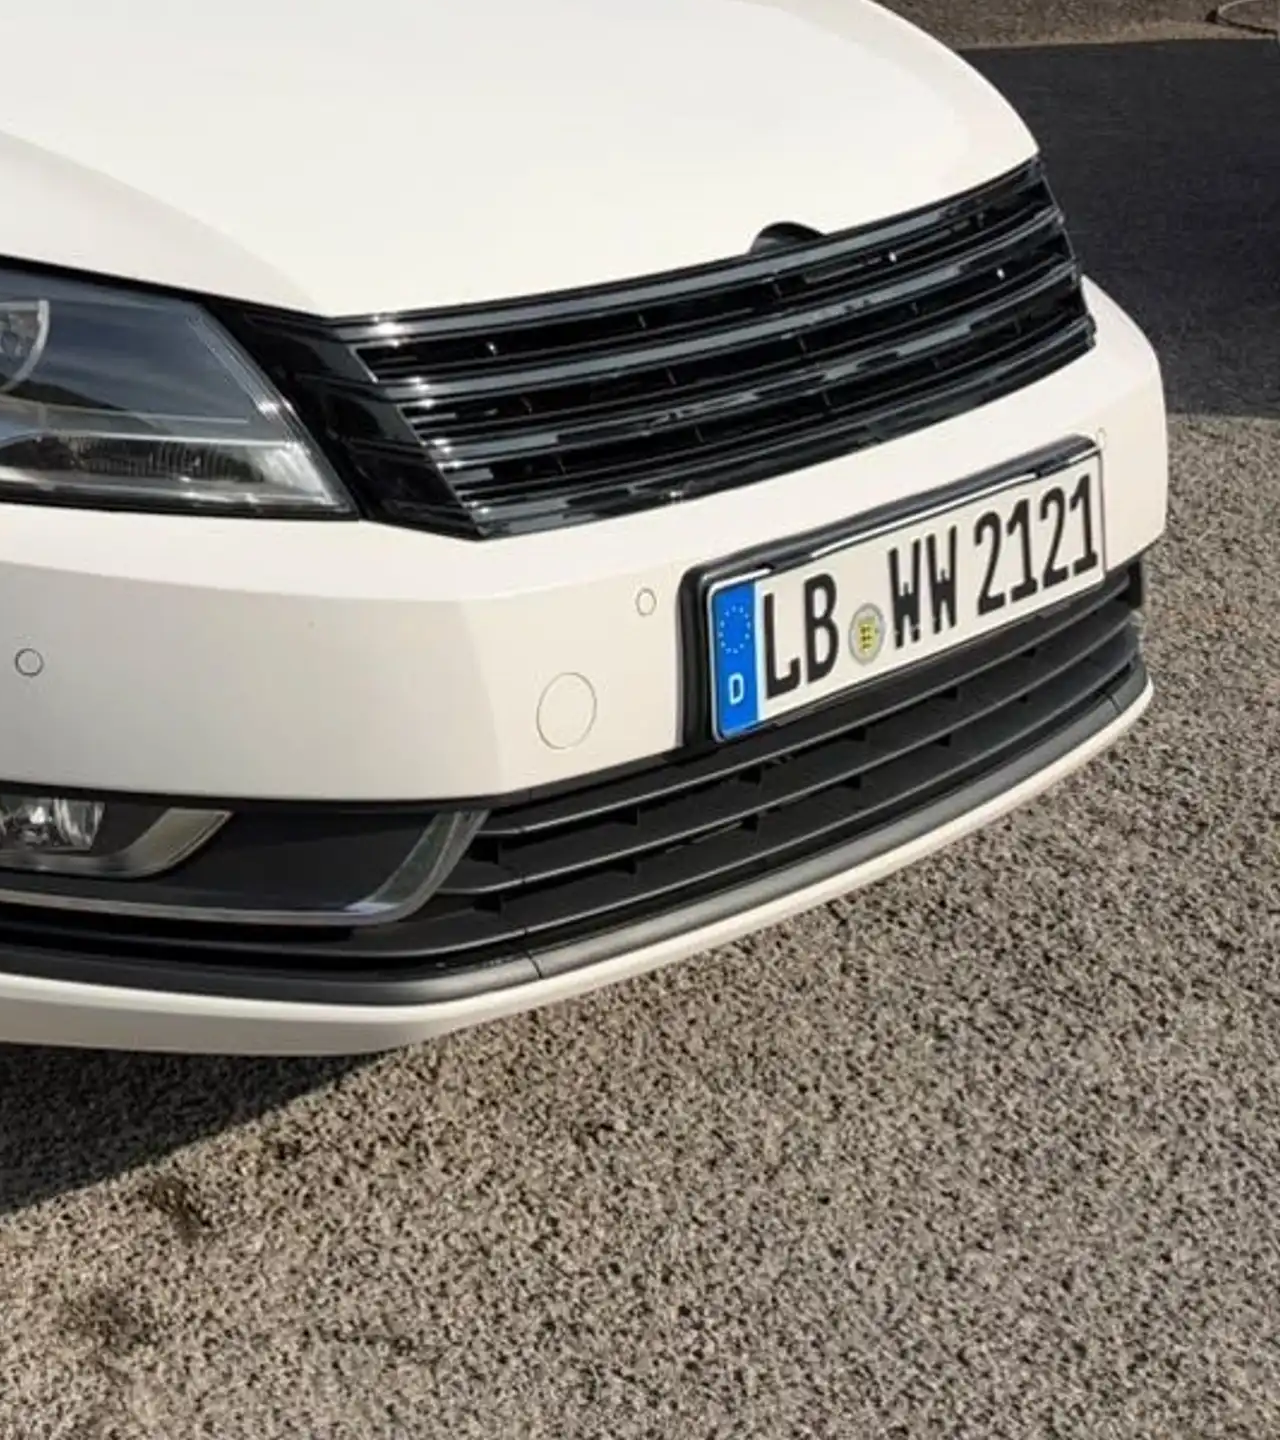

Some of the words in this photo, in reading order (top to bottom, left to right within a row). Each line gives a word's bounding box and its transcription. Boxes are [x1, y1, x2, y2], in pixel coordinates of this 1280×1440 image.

[763, 572, 839, 699] LB
[888, 525, 957, 649] WW
[974, 474, 1098, 615] 2121
[728, 673, 744, 705] D
